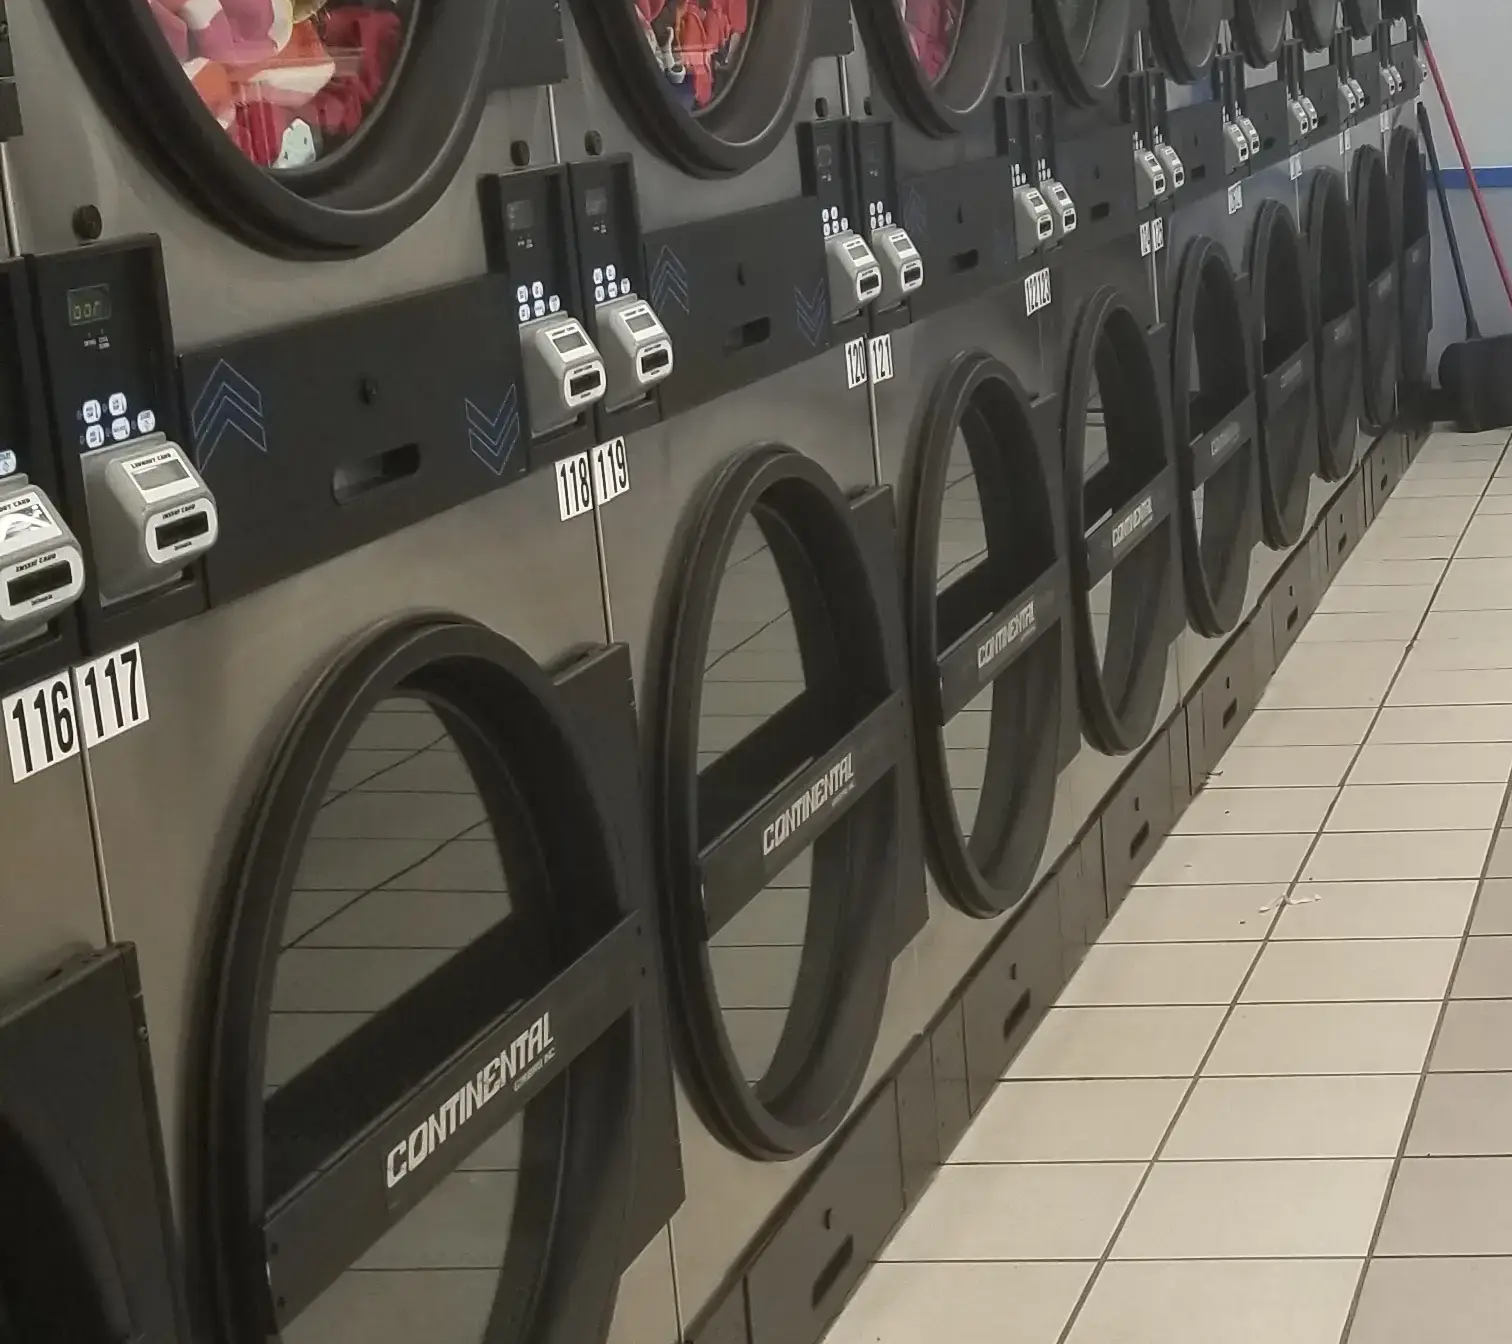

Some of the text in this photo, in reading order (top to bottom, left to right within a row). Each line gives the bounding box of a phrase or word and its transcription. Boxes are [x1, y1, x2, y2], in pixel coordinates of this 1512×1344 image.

[847, 335, 893, 385] 120 121
[560, 439, 628, 515] 118 119
[977, 601, 1035, 669] CONTINENTAL
[12, 648, 139, 773] 116 117
[763, 752, 854, 856] CONTINENTAL
[387, 1011, 554, 1188] CONTINENTAL
